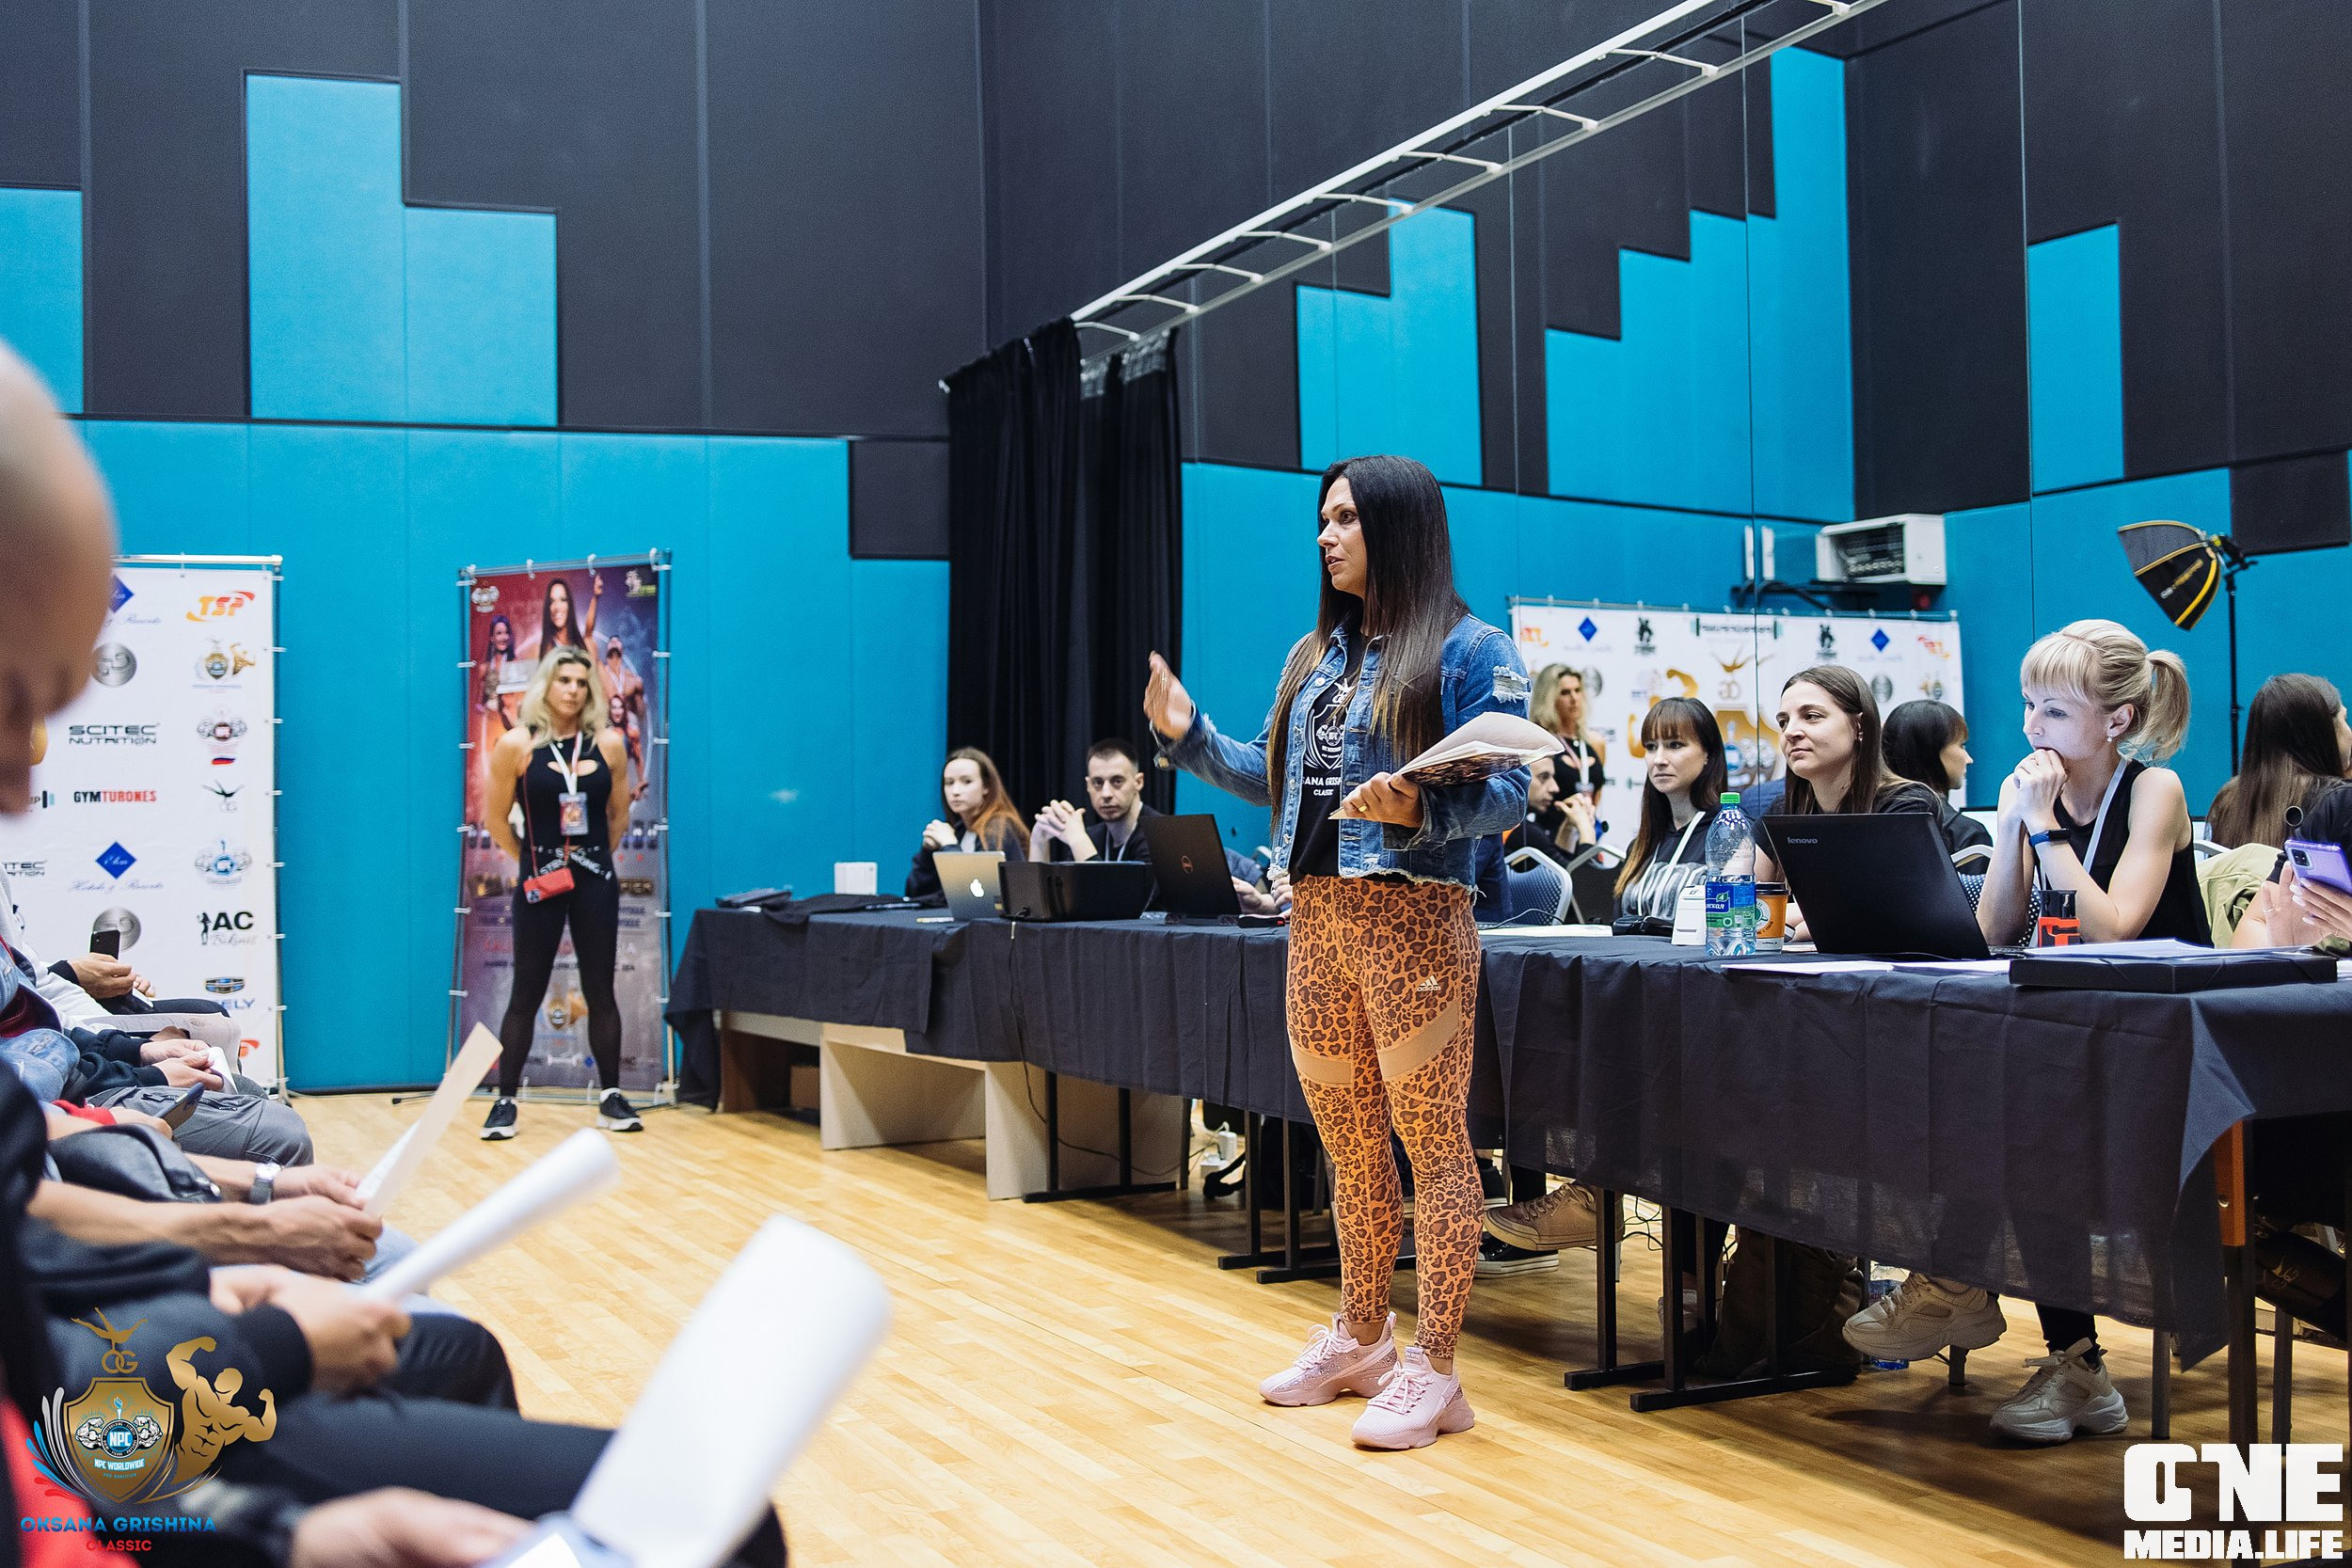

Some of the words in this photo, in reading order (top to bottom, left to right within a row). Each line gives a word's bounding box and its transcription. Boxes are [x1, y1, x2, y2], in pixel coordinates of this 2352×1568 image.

[198, 595, 245, 617] TSP
[69, 724, 157, 736] SCITEC
[69, 736, 157, 746] NUTRITION
[213, 911, 254, 930] AC
